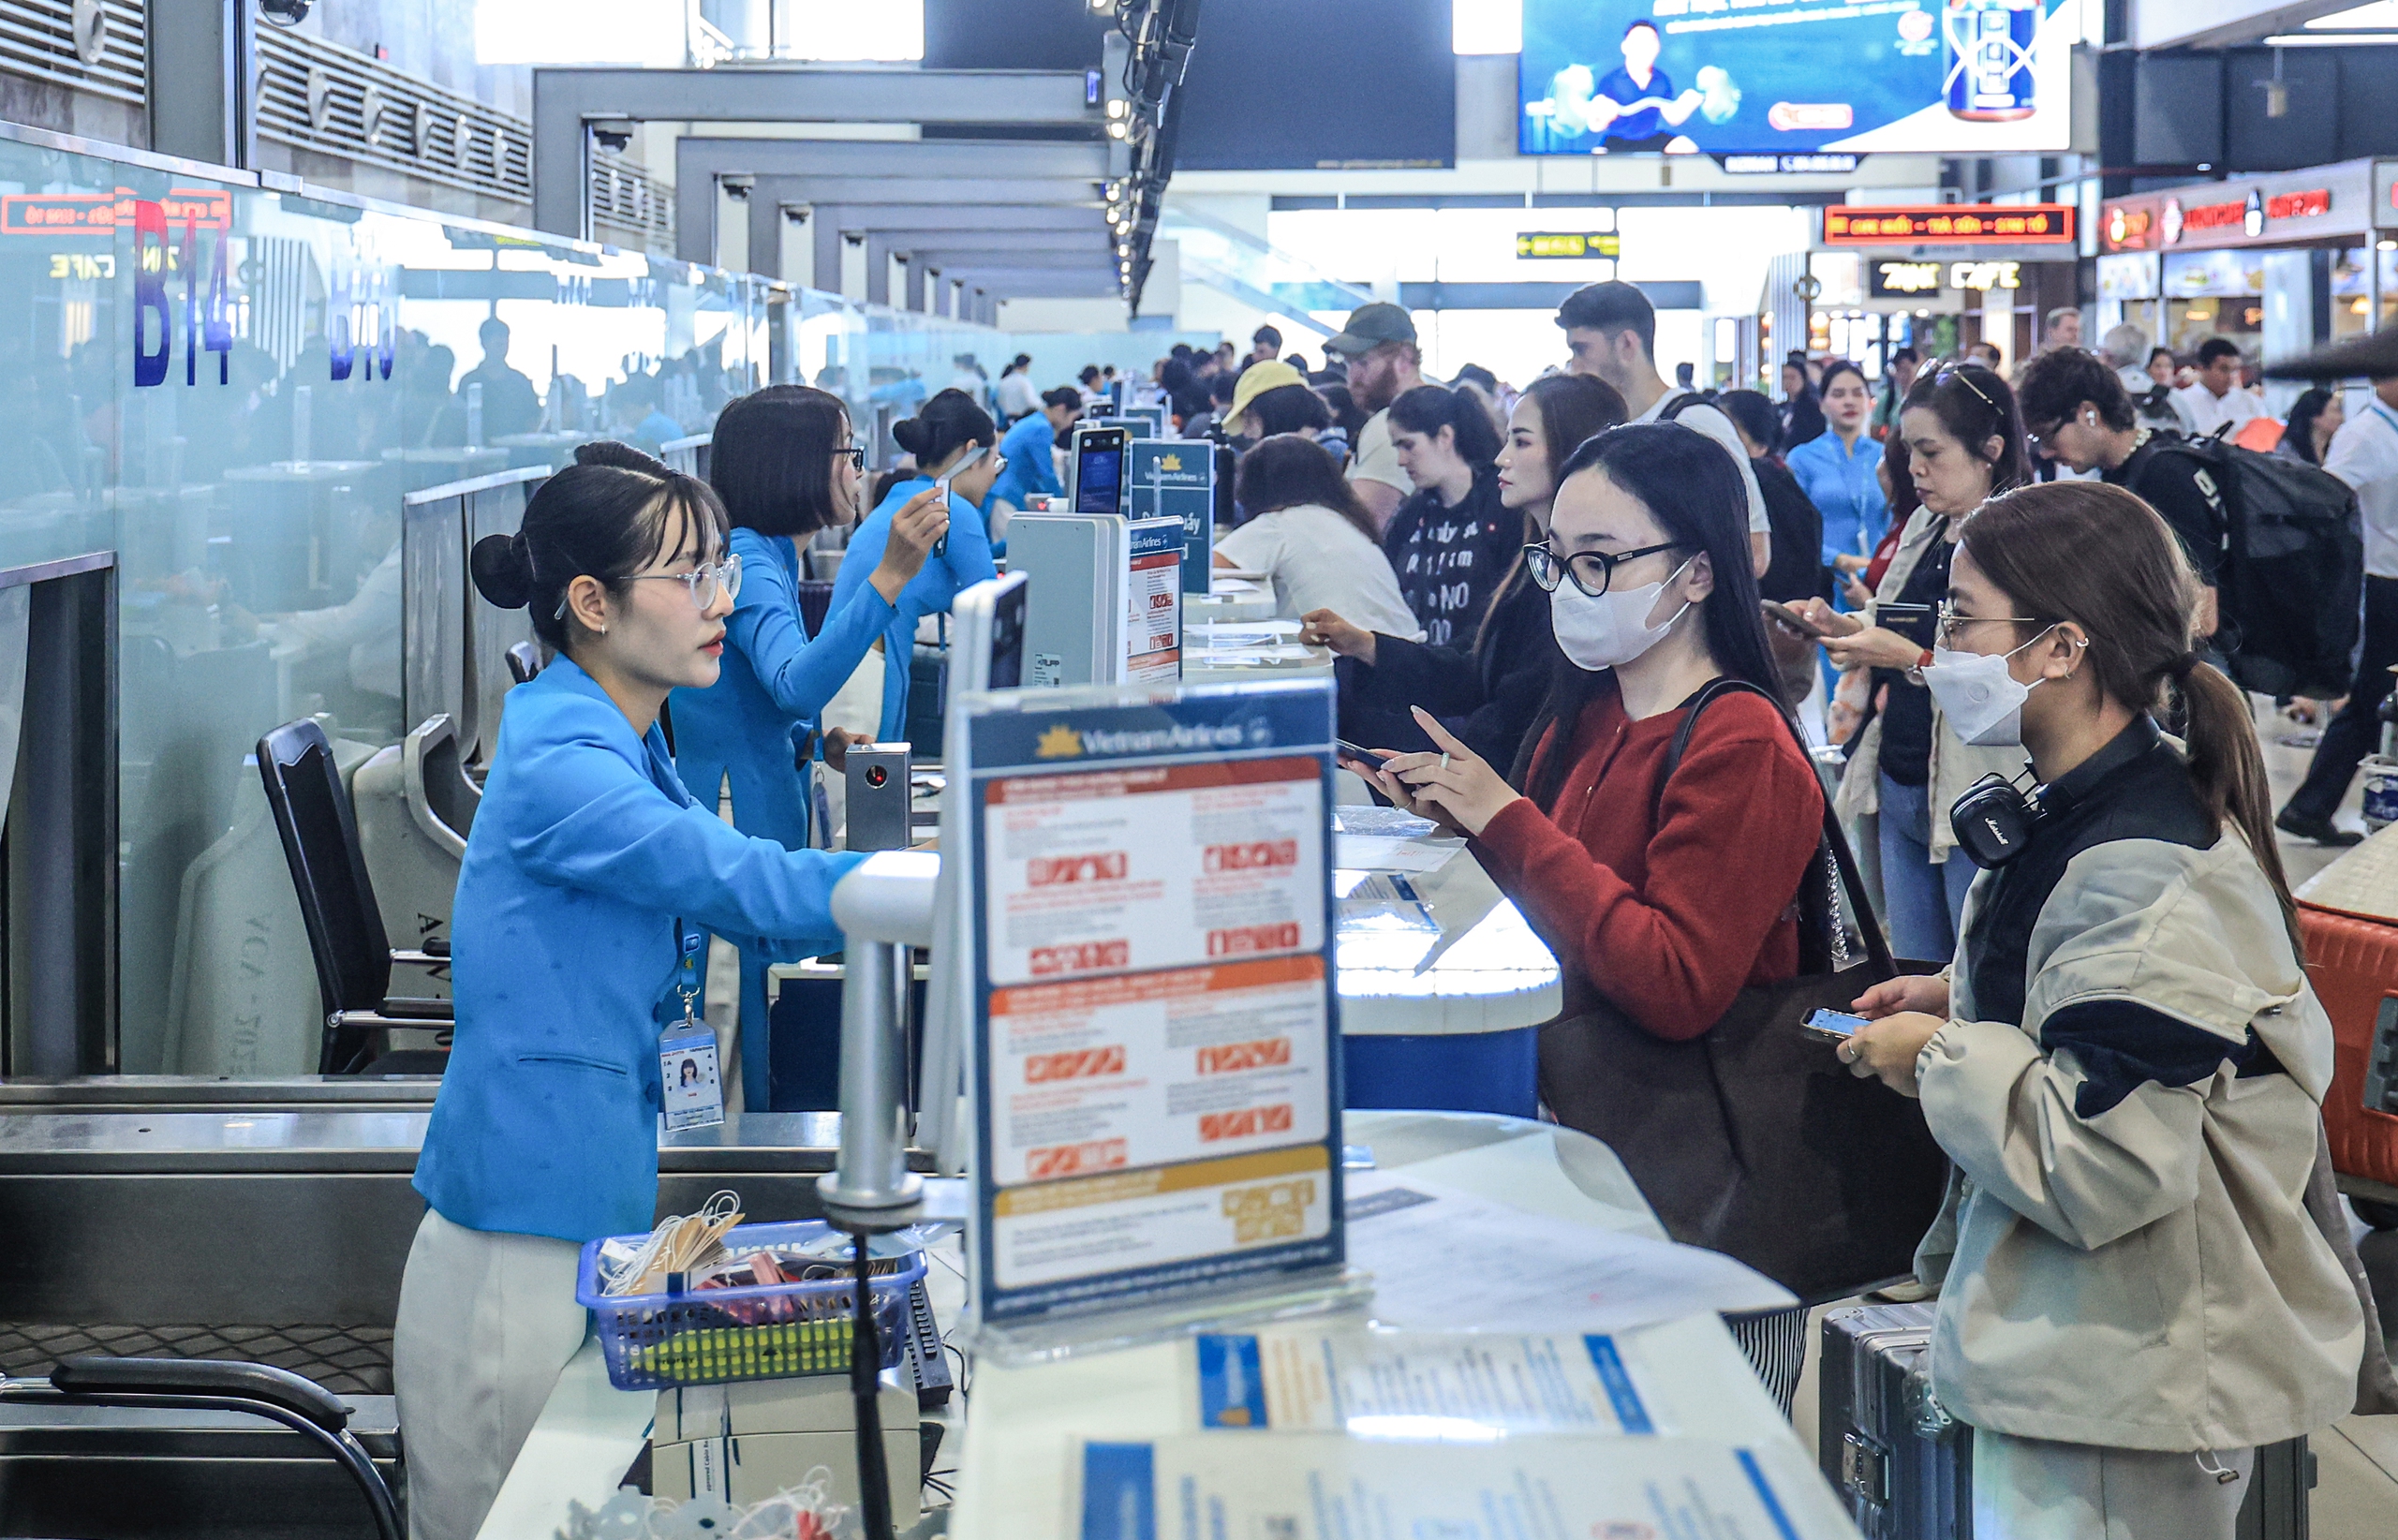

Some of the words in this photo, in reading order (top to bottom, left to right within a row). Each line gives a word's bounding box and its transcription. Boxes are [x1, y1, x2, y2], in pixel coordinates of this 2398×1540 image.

[1950, 262, 2021, 291] CAFE
[135, 200, 231, 387] B14
[1985, 817, 2009, 845] Marshall
